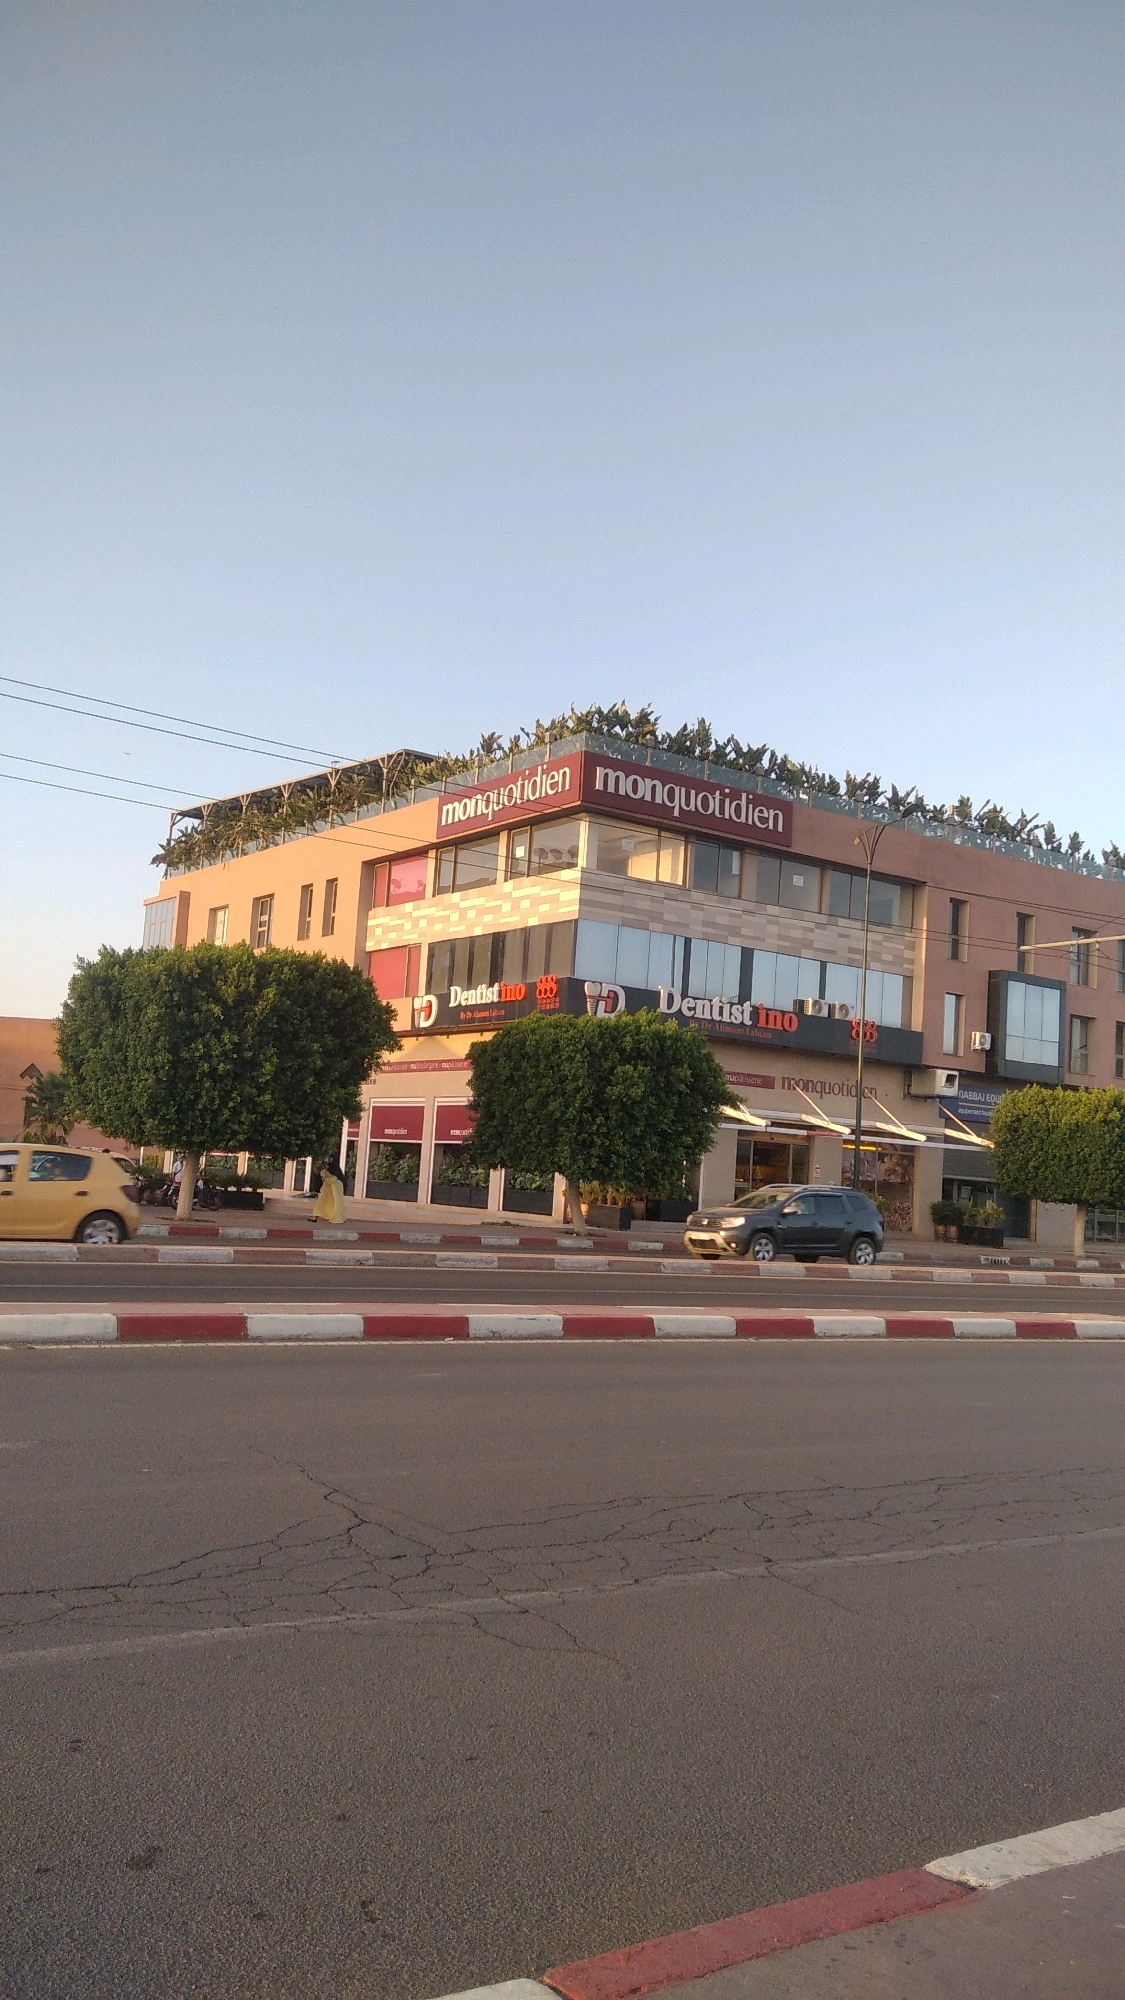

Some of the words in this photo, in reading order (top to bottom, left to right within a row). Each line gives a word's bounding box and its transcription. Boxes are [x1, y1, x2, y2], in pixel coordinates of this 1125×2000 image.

[441, 764, 570, 826] monquotidien
[595, 766, 784, 832] monquotidien
[781, 1076, 877, 1099] monquotiden
[958, 1090, 985, 1102] DABBAJ
[986, 1093, 1003, 1106] EQUI
